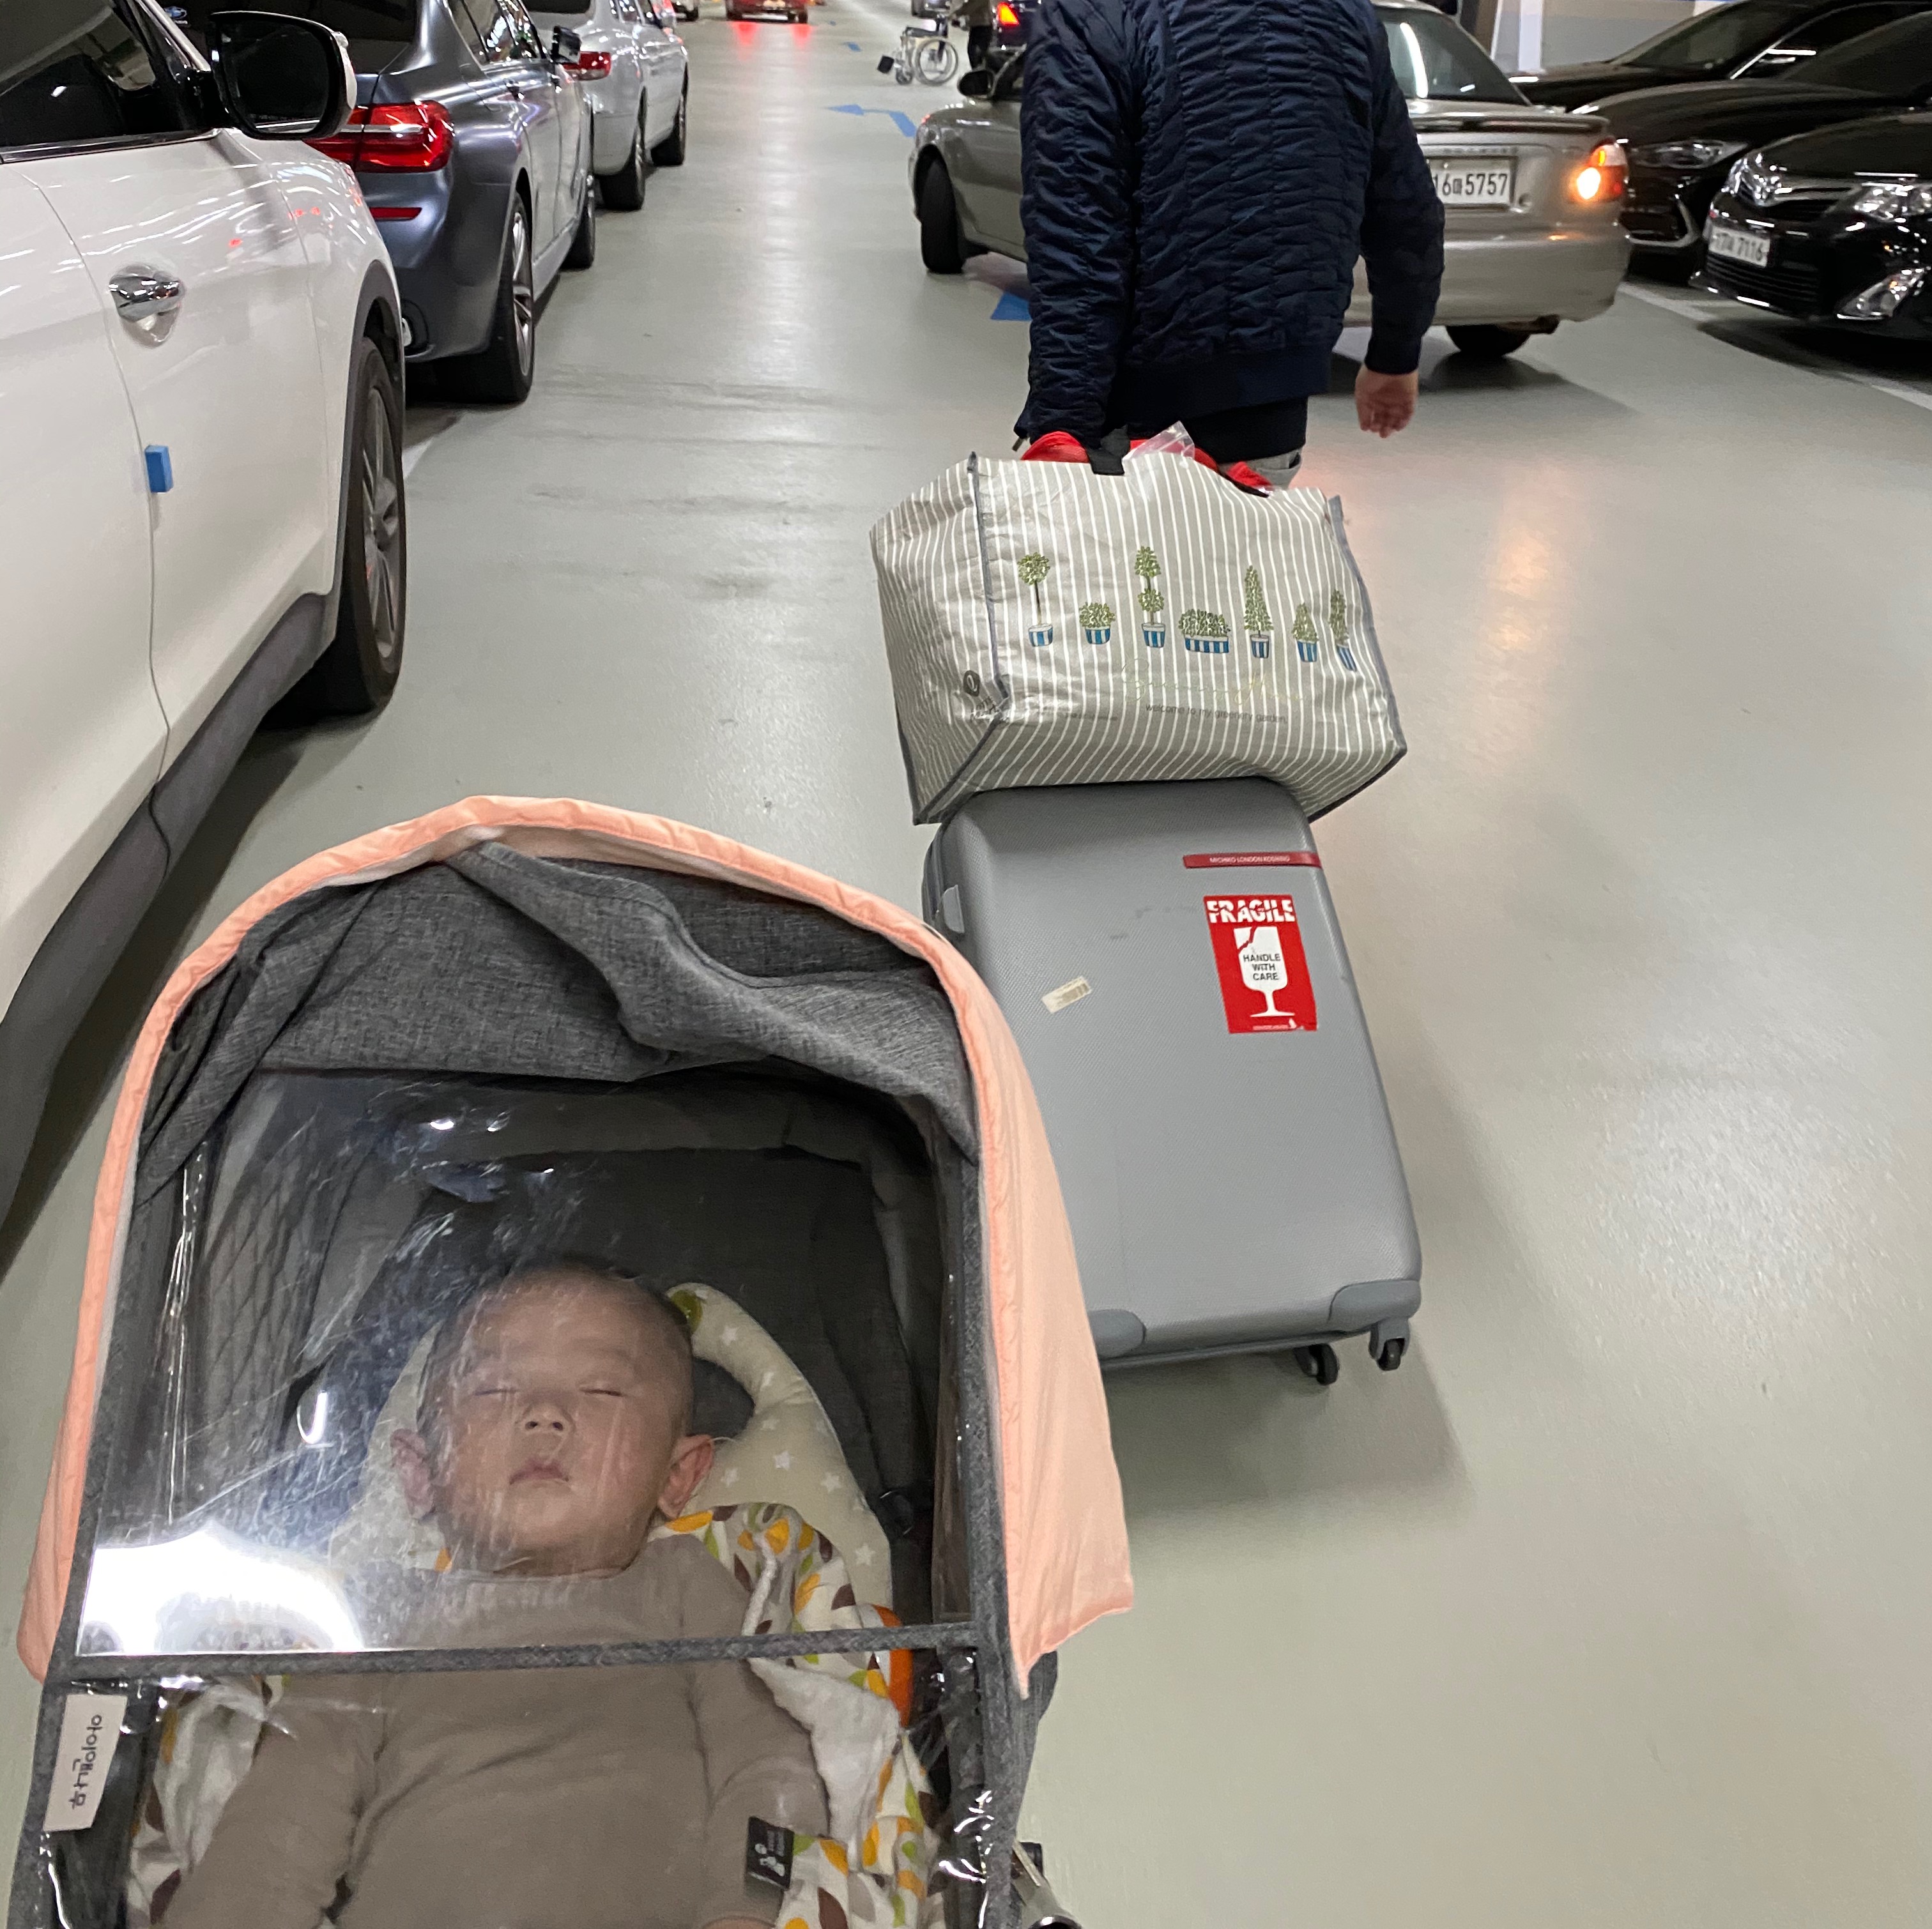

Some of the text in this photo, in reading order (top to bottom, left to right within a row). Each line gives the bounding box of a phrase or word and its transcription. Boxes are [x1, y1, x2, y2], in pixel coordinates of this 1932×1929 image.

[1199, 709, 1211, 718] my
[1207, 899, 1295, 923] FRAGILE
[1243, 953, 1281, 962] HANDLE
